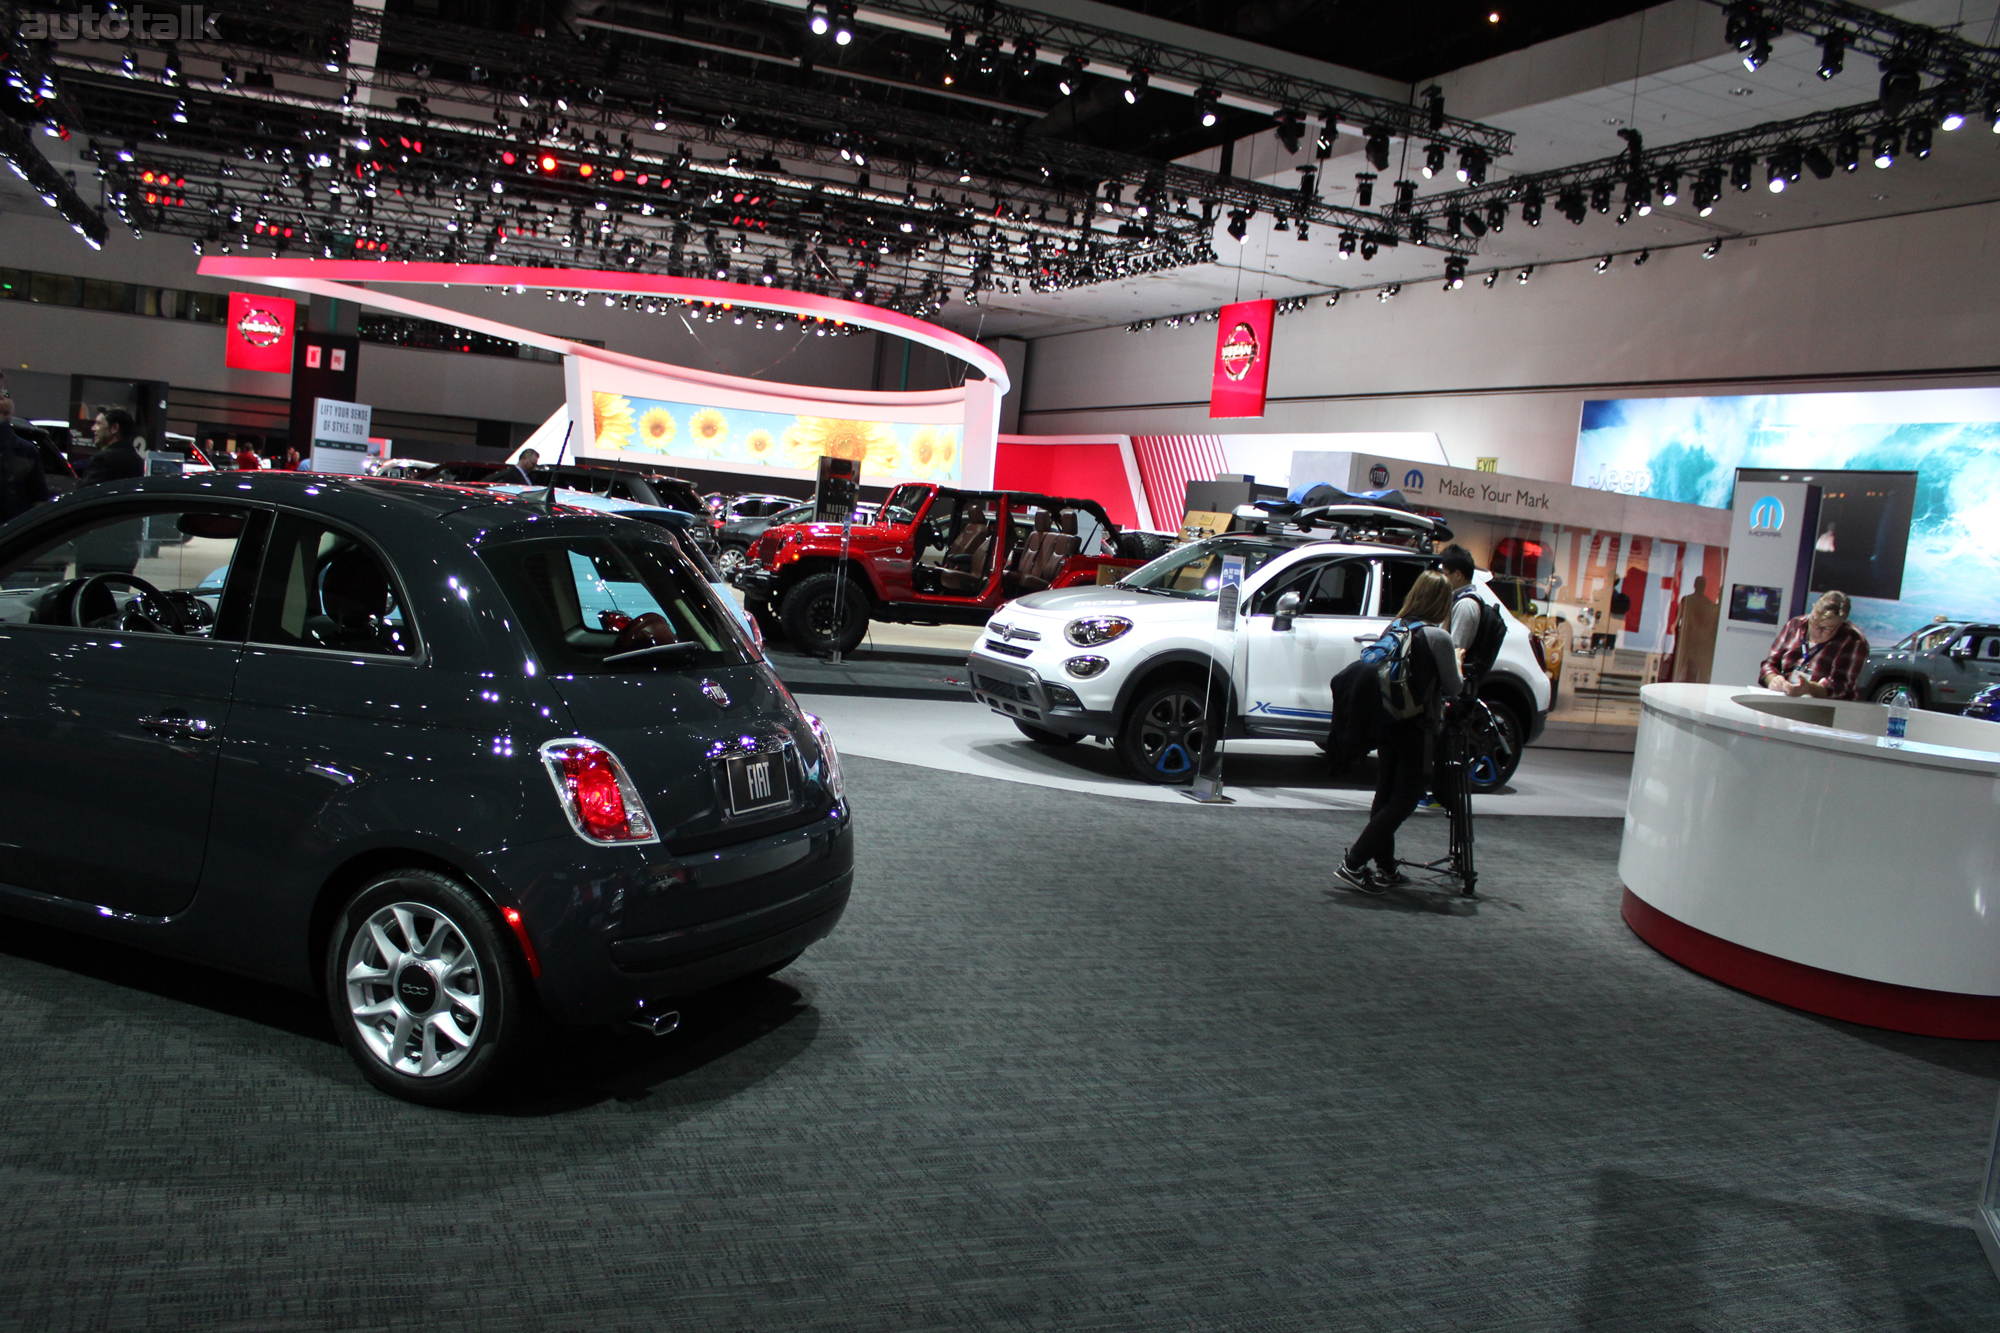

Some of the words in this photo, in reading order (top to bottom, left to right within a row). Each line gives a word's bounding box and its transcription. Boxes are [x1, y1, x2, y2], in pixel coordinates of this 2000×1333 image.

[1222, 344, 1252, 359] NISSAN
[320, 404, 333, 416] LIFT
[334, 406, 349, 418] YOUR
[350, 408, 369, 421] SENSE
[323, 420, 332, 431] OF
[352, 423, 364, 435] TOO
[1478, 459, 1496, 473] EXIT
[1588, 463, 1651, 497] Jeep
[1438, 478, 1475, 499] Make
[1481, 484, 1512, 503] Your
[1516, 489, 1550, 510] Mark
[826, 503, 849, 515] MASTER
[746, 761, 771, 800] FIAT
[402, 983, 429, 996] 500
